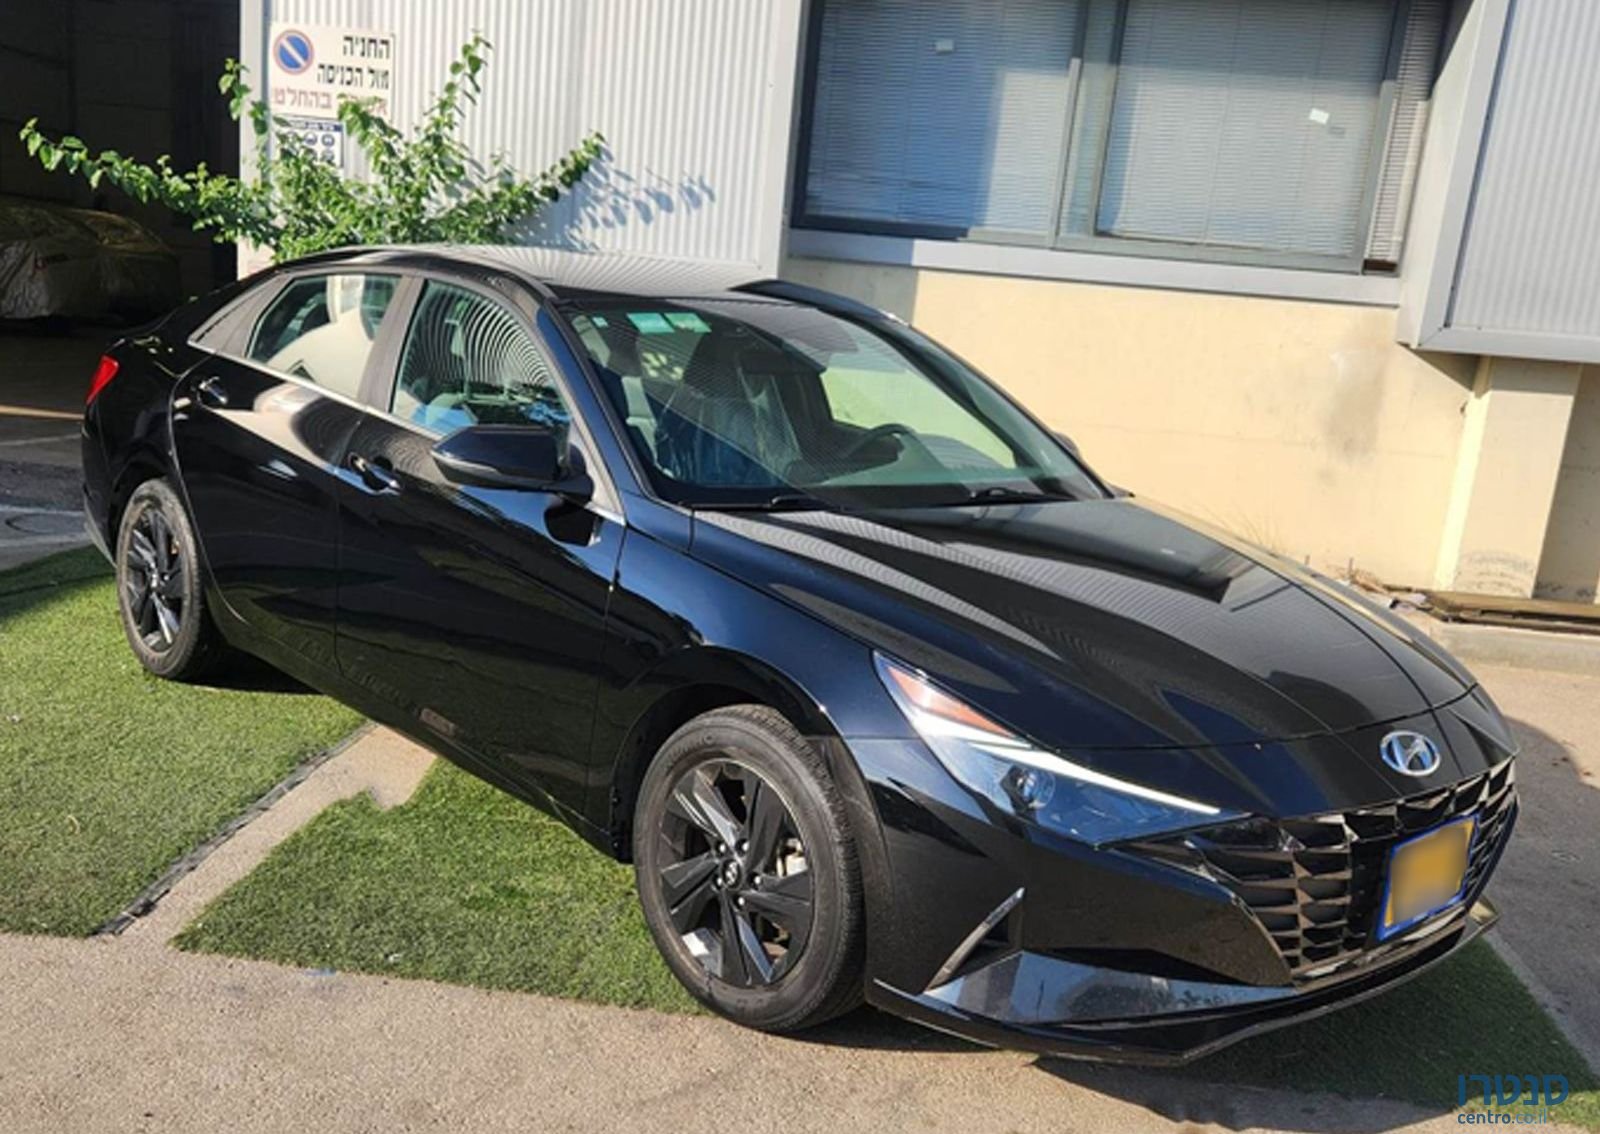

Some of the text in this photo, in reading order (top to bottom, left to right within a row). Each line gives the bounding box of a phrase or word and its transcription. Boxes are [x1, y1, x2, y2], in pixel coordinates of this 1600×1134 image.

[343, 35, 390, 59] החניה
[317, 63, 363, 87] הכניסה
[273, 87, 333, 109] בהחלט
